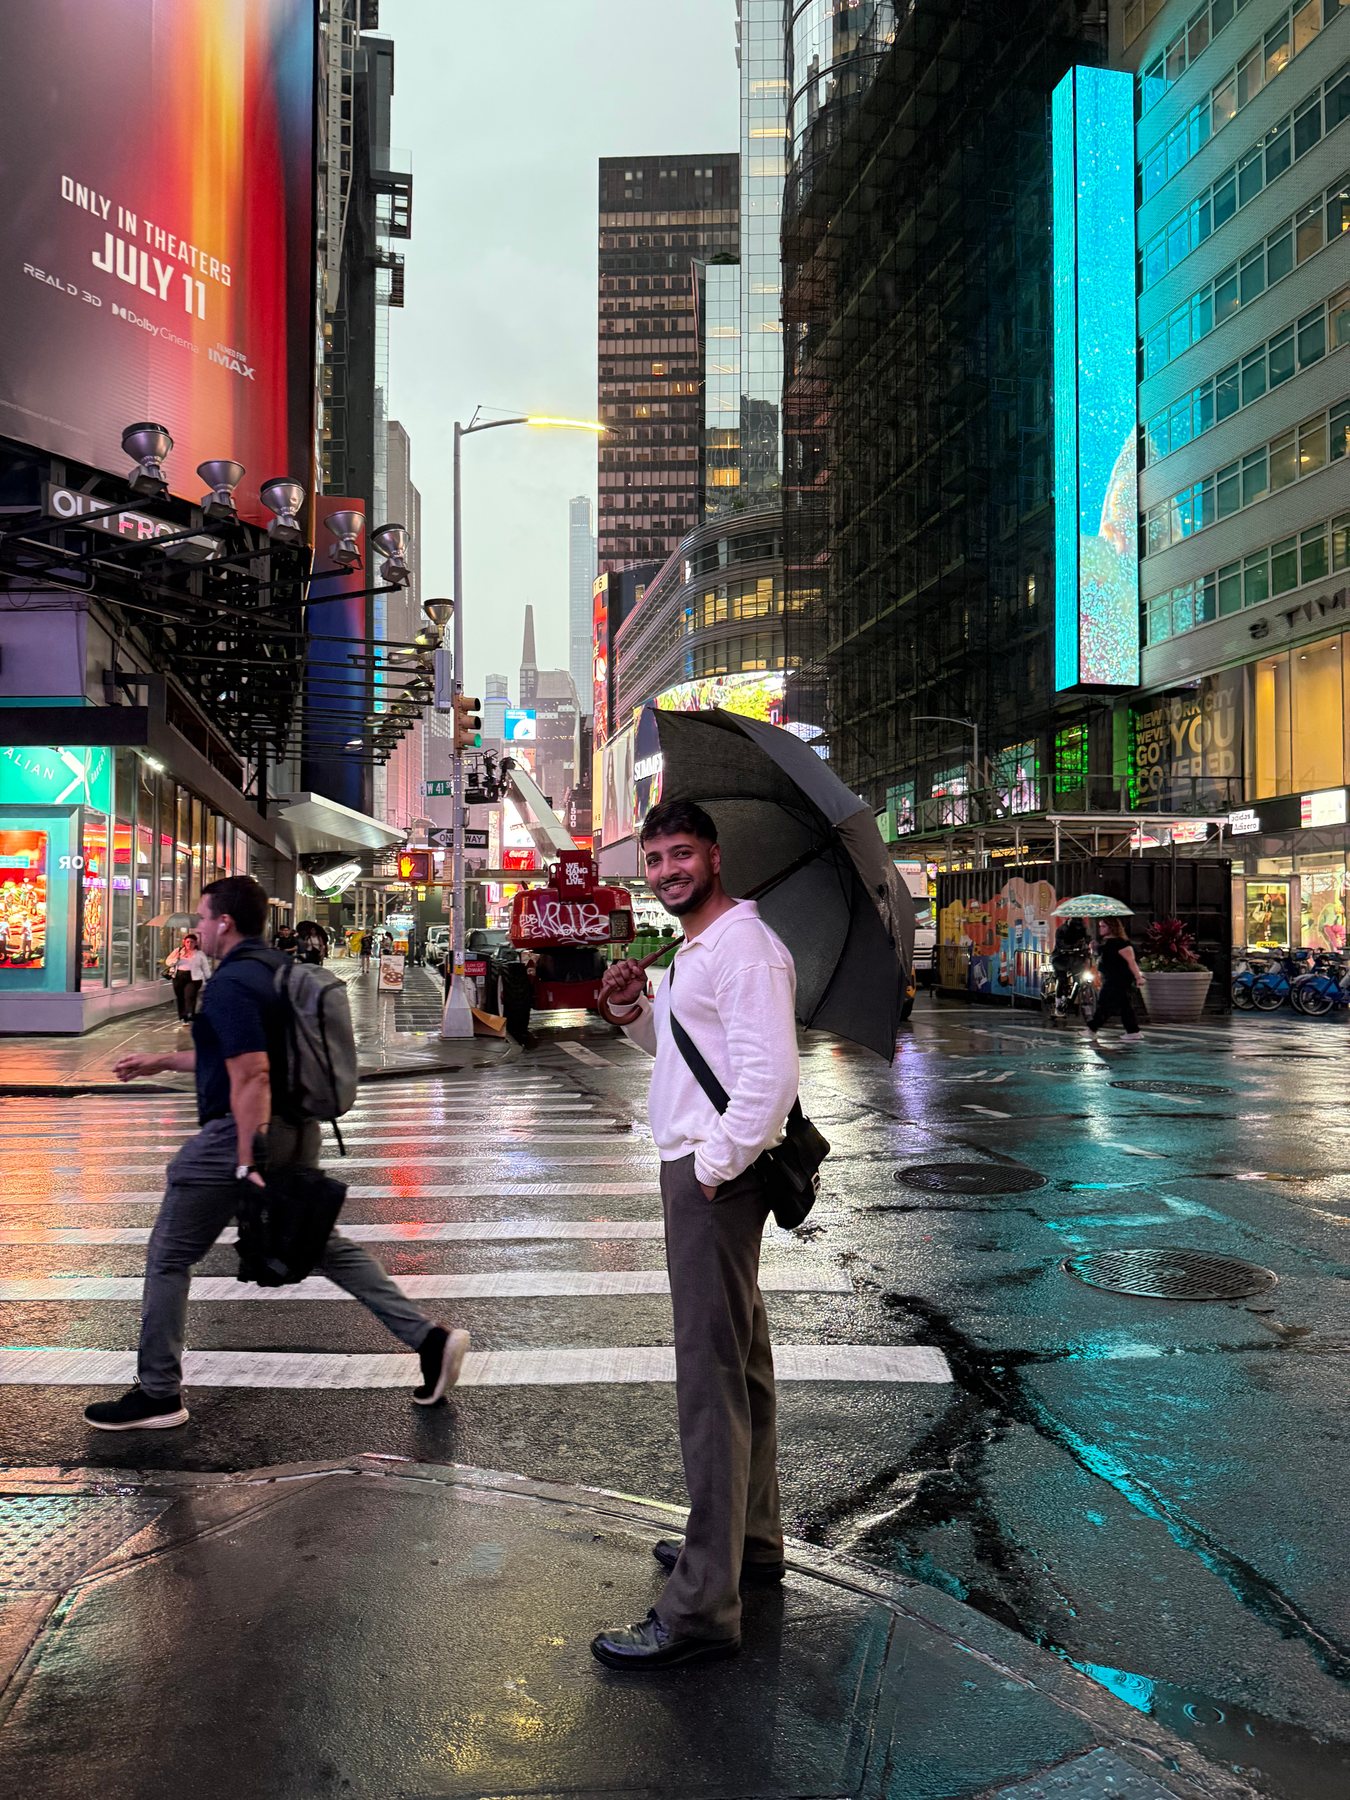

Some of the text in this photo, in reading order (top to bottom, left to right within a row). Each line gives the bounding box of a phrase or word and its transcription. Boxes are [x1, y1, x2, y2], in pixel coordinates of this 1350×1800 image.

[61, 175, 231, 287] ONLY IN THEATERS
[81, 290, 102, 307] 3D
[92, 232, 206, 321] JULY 11
[127, 310, 199, 354] Dolby Cinema
[208, 347, 256, 381] IMAX
[1136, 687, 1234, 732] NEW YORK CITY
[1136, 707, 1235, 767] GOT YOU
[427, 783, 433, 794] W
[435, 782, 444, 794] 41
[1136, 750, 1235, 794] COVERED
[464, 835, 482, 843] WAY
[565, 867, 588, 875] HANG
